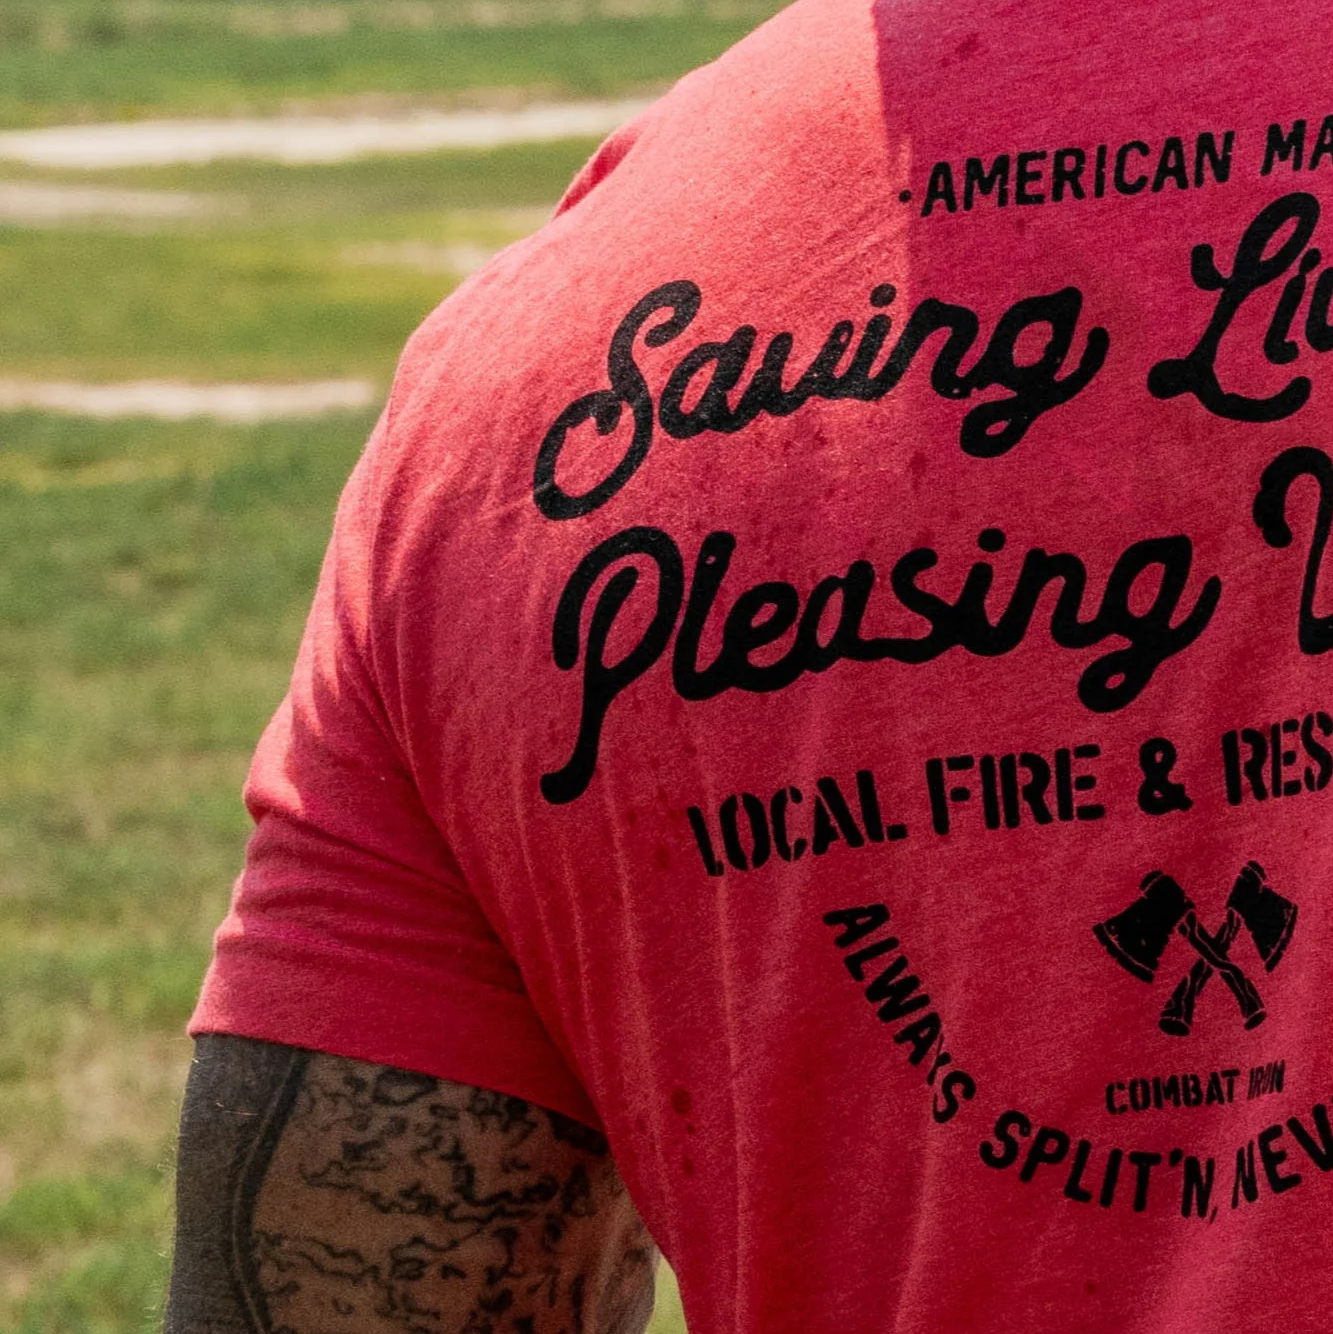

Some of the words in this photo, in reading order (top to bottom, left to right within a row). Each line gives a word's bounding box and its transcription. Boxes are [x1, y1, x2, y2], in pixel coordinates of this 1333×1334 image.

[921, 130, 1235, 217] AMERICAN
[533, 280, 1110, 520] Saving
[540, 525, 1223, 805] Pleasing
[686, 769, 908, 878] LOCAL
[925, 743, 1106, 835] FIRE
[1137, 736, 1194, 816] &
[1105, 1068, 1241, 1115] COMBAT
